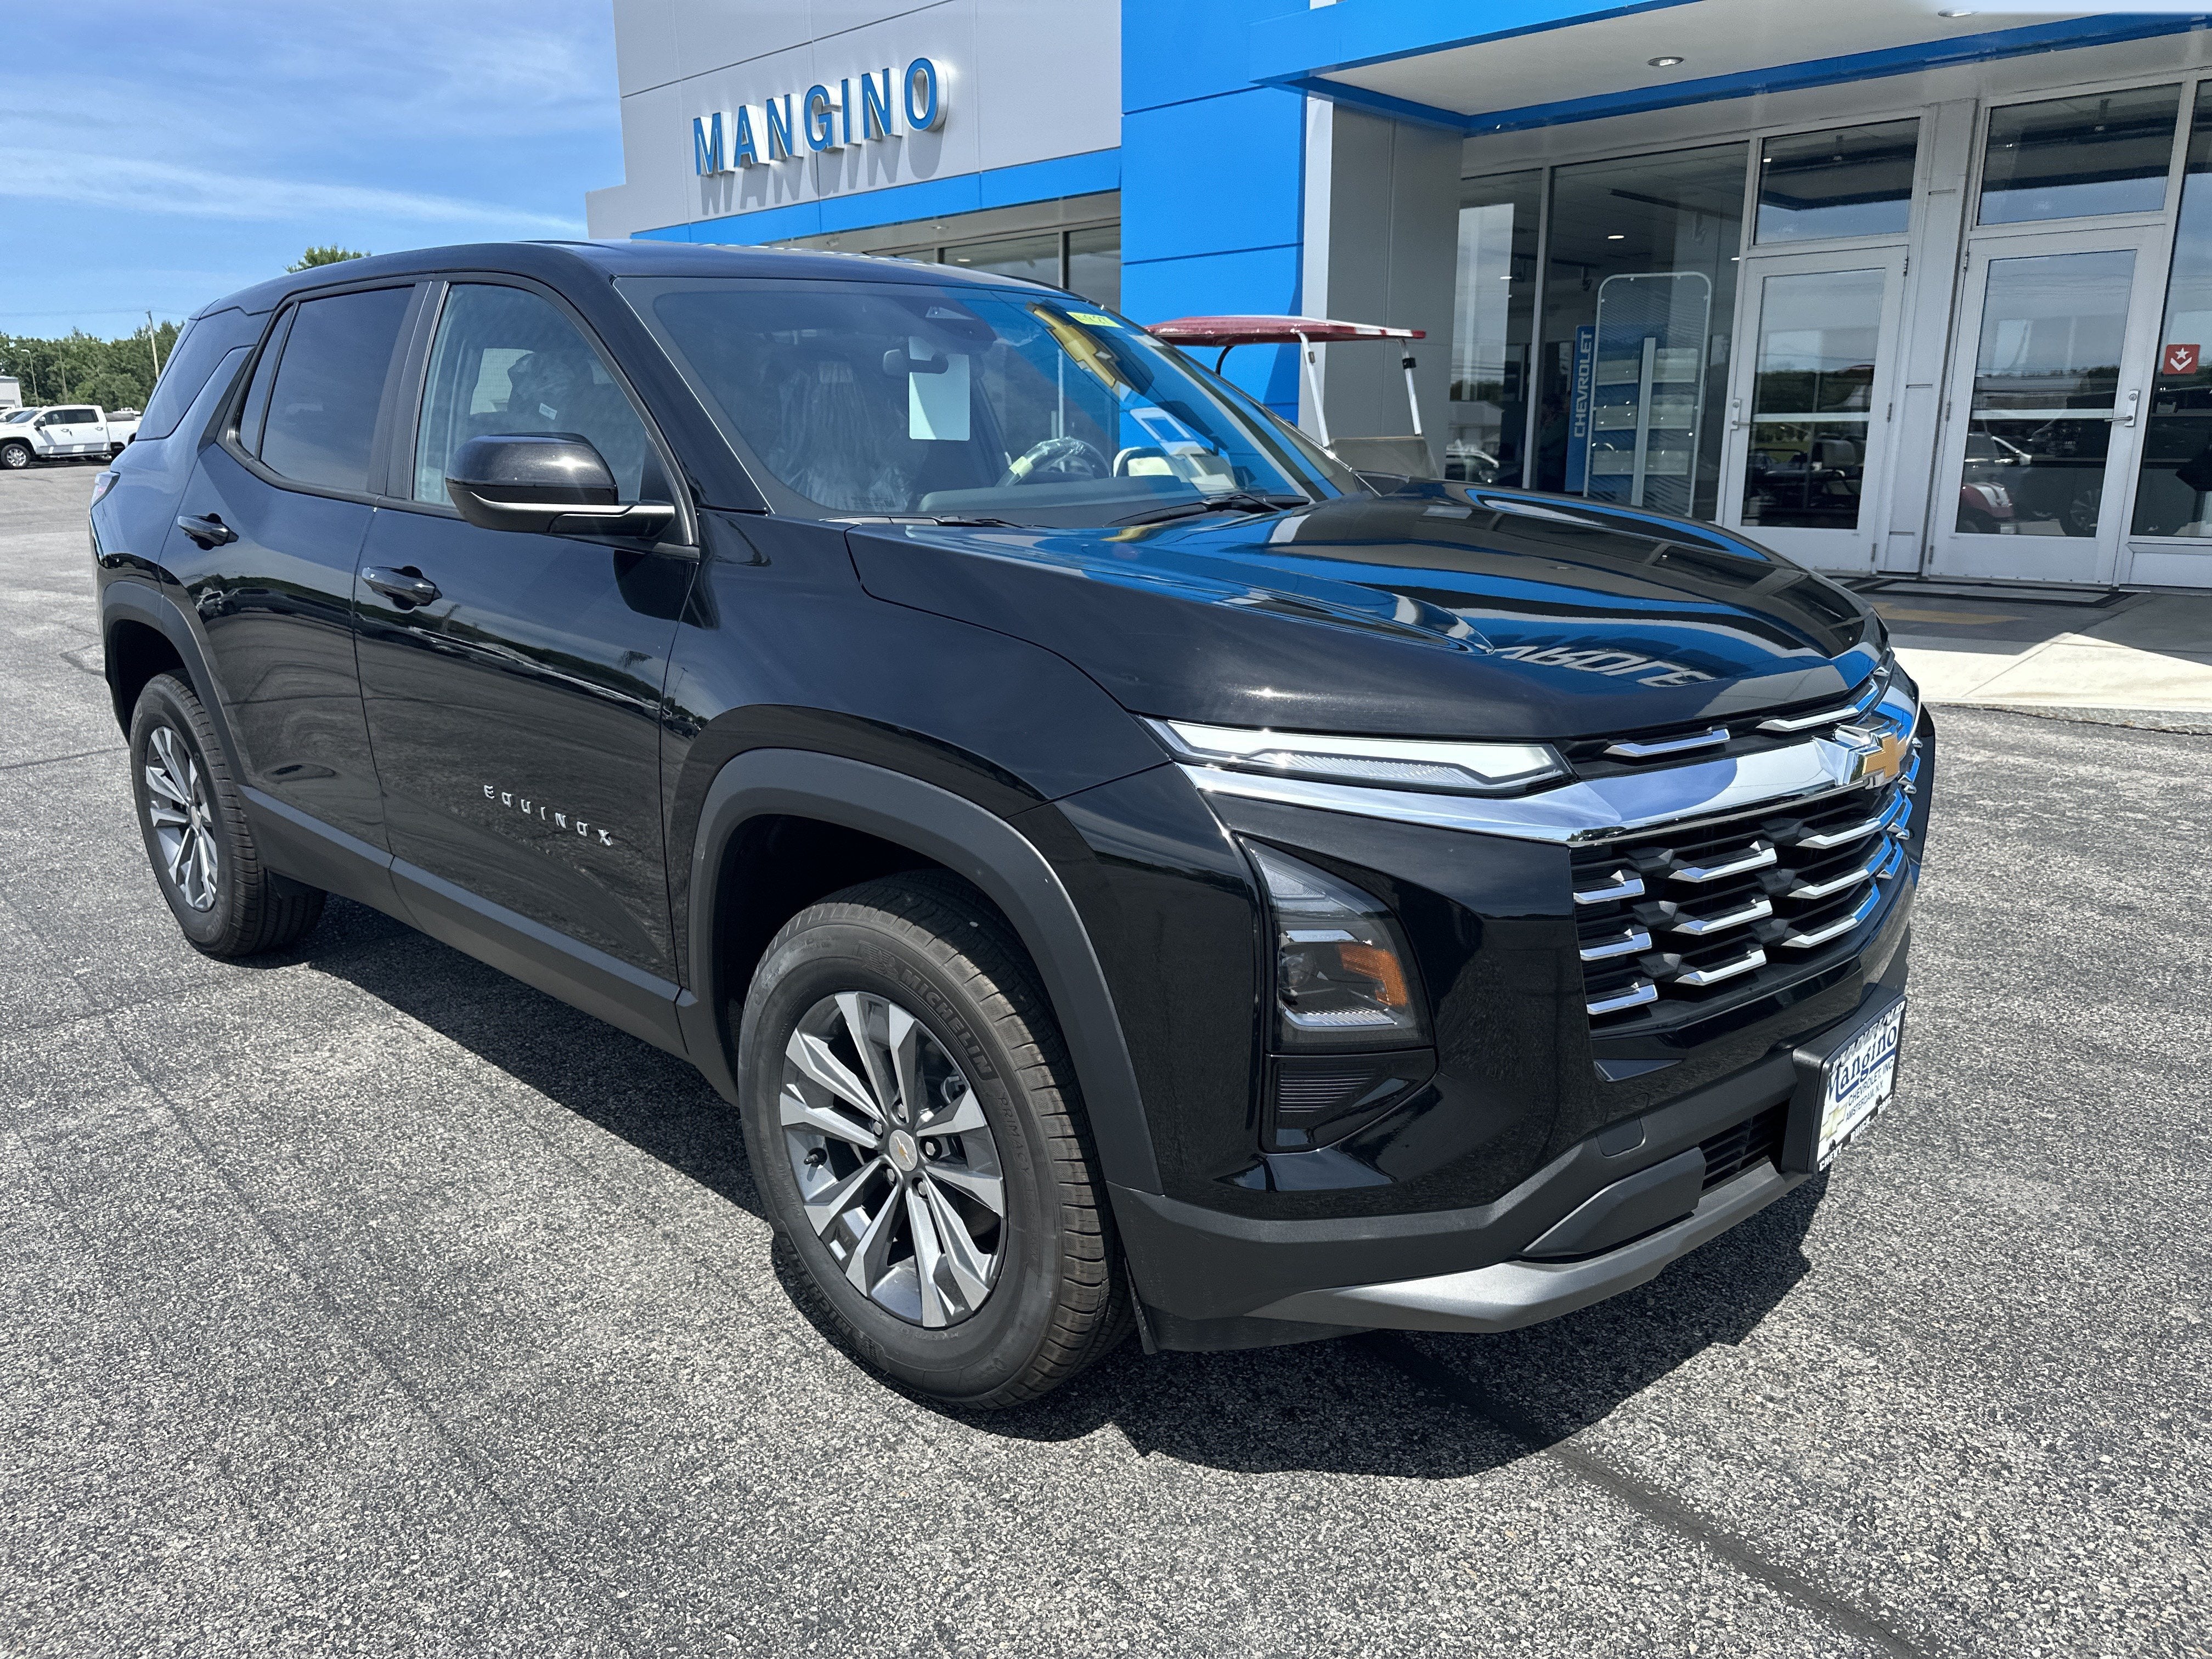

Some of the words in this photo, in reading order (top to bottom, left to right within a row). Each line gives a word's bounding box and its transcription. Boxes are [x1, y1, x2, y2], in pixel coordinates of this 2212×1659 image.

[693, 57, 948, 177] MANGINO
[1574, 330, 1592, 438] CHEVROLET
[483, 785, 613, 846] EQUINOX
[900, 968, 992, 1074] MICHELIN
[1819, 1143, 1843, 1172] CHEVY
[1850, 1115, 1871, 1142] BUICK
[1877, 1094, 1893, 1115] GMC
